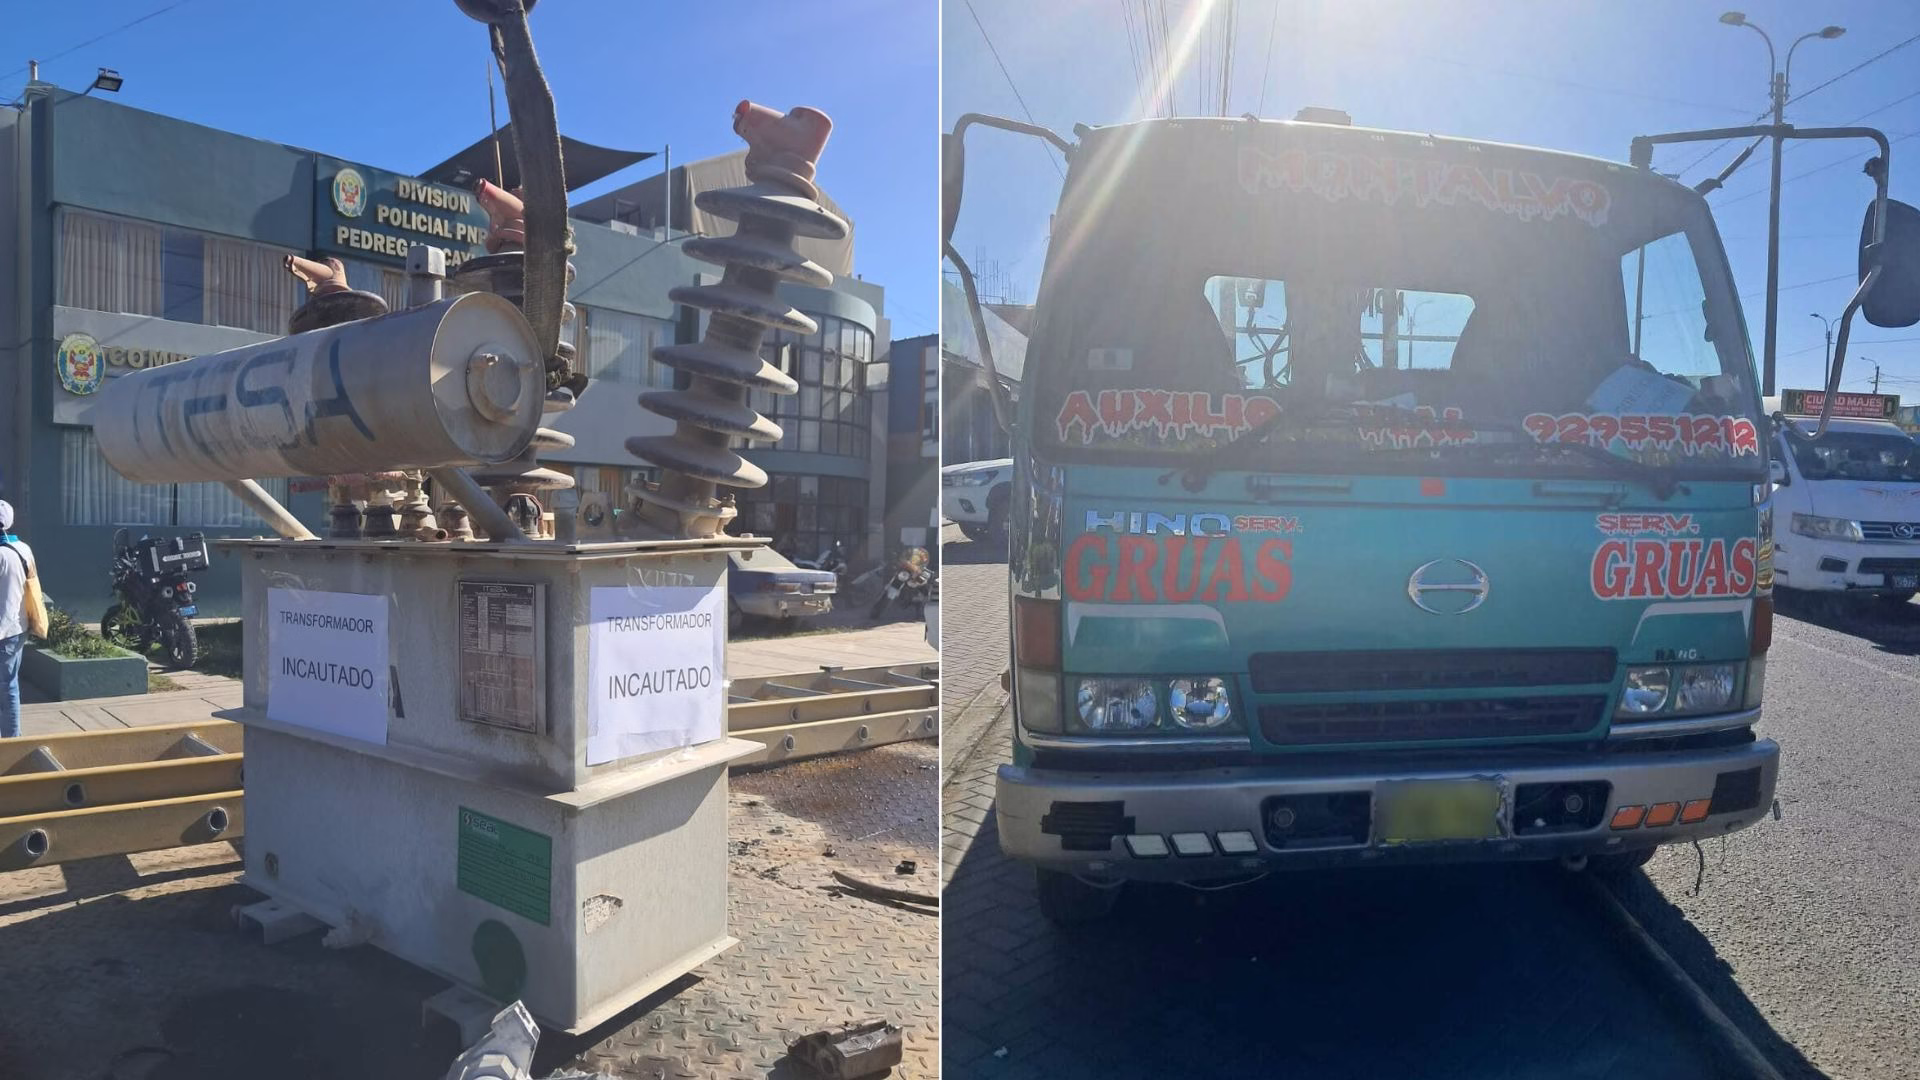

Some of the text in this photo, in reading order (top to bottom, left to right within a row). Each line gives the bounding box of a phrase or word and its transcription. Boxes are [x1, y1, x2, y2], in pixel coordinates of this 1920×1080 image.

[398, 180, 471, 214] DIVISION
[1237, 146, 1612, 228] MONTALVO
[377, 204, 453, 239] POLICIAL
[337, 225, 425, 257] PEDREG
[1806, 394, 1882, 408] CIUD MAJES
[1056, 388, 1283, 444] AUXILIO
[1522, 412, 1759, 457] 929551212
[1085, 510, 1232, 537] HINO
[1234, 514, 1304, 534] SERV.
[1596, 512, 1701, 537] SERV.
[1063, 535, 1295, 604] GRUAS
[1590, 537, 1757, 600] GRUAS
[280, 610, 374, 634] TRANSFORMADOR
[606, 612, 712, 633] TRANSFORMADOR
[282, 656, 374, 690] INCAUTADO
[608, 665, 712, 700] INCAUTADO
